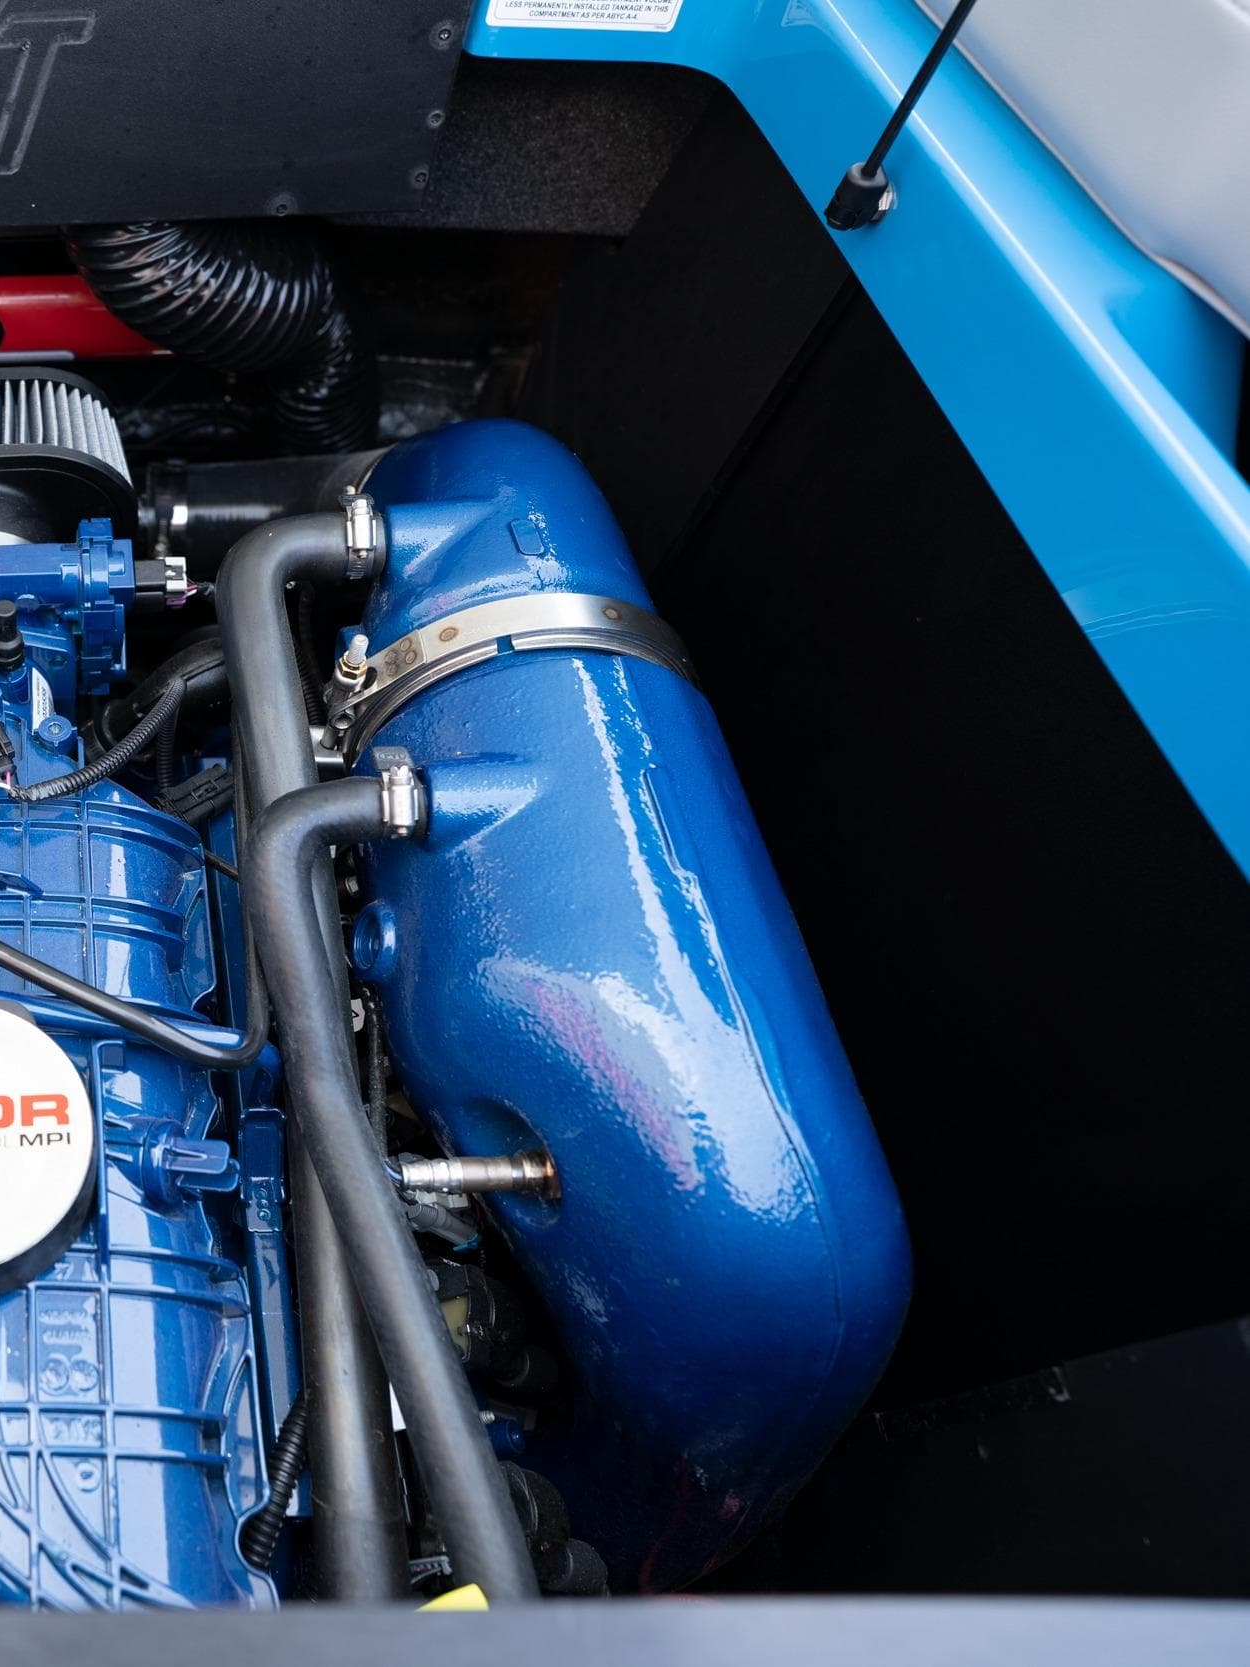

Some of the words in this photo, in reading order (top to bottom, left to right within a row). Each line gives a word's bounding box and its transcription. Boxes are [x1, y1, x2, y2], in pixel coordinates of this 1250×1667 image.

[523, 2, 573, 10] PERMANENTLY
[574, 3, 610, 11] INSTALLED
[611, 4, 644, 12] TANKAGE
[653, 5, 669, 13] THIS
[529, 10, 579, 19] COMPARTMENT
[19, 1132, 71, 1147] MPI
